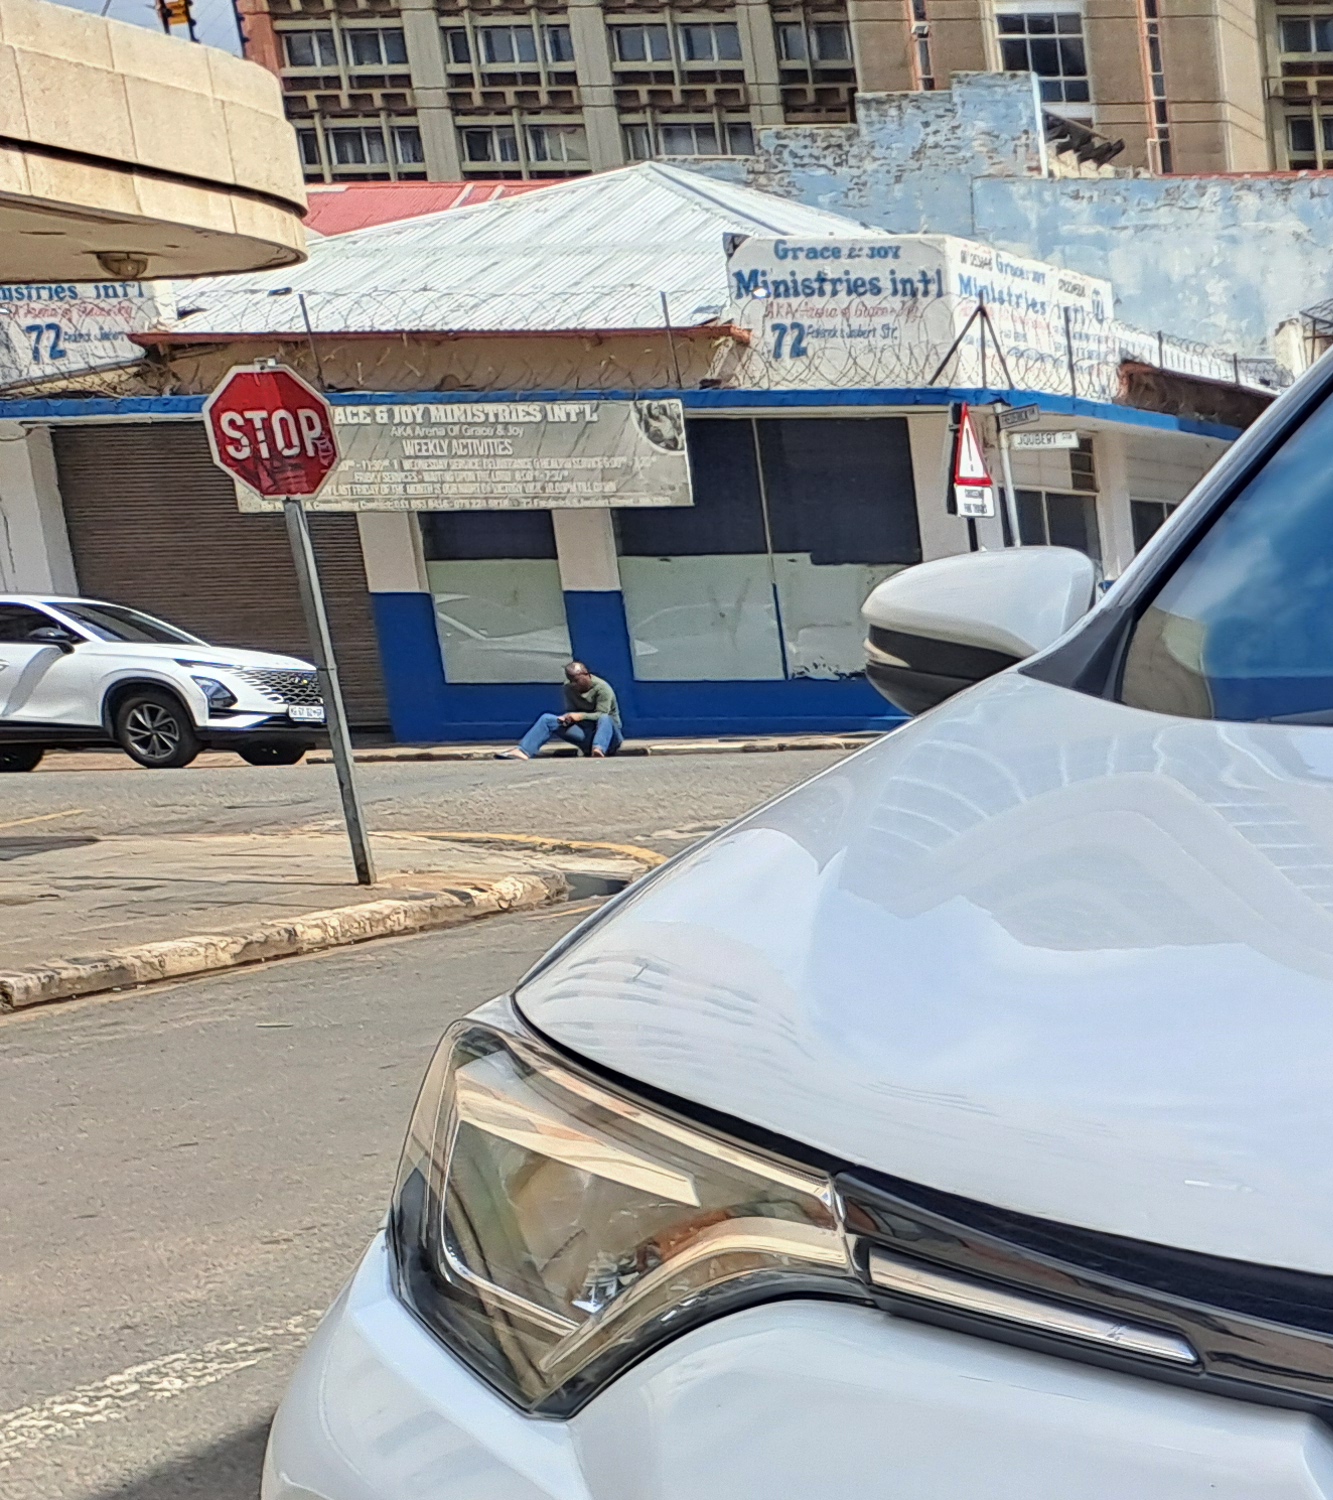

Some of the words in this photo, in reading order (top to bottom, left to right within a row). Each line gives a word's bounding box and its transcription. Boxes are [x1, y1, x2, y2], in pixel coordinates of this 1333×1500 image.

[774, 239, 842, 260] Grace
[732, 268, 882, 300] Ministries
[25, 323, 67, 363] 72
[771, 322, 808, 359] 72
[333, 406, 371, 425] ACE
[393, 404, 425, 424] JOY
[430, 403, 543, 423] MINISTRIES
[220, 408, 323, 461] STOP
[402, 439, 449, 457] WEEKLY
[451, 438, 514, 457] ACTIVITIES
[1017, 432, 1057, 447] JOUBERT
